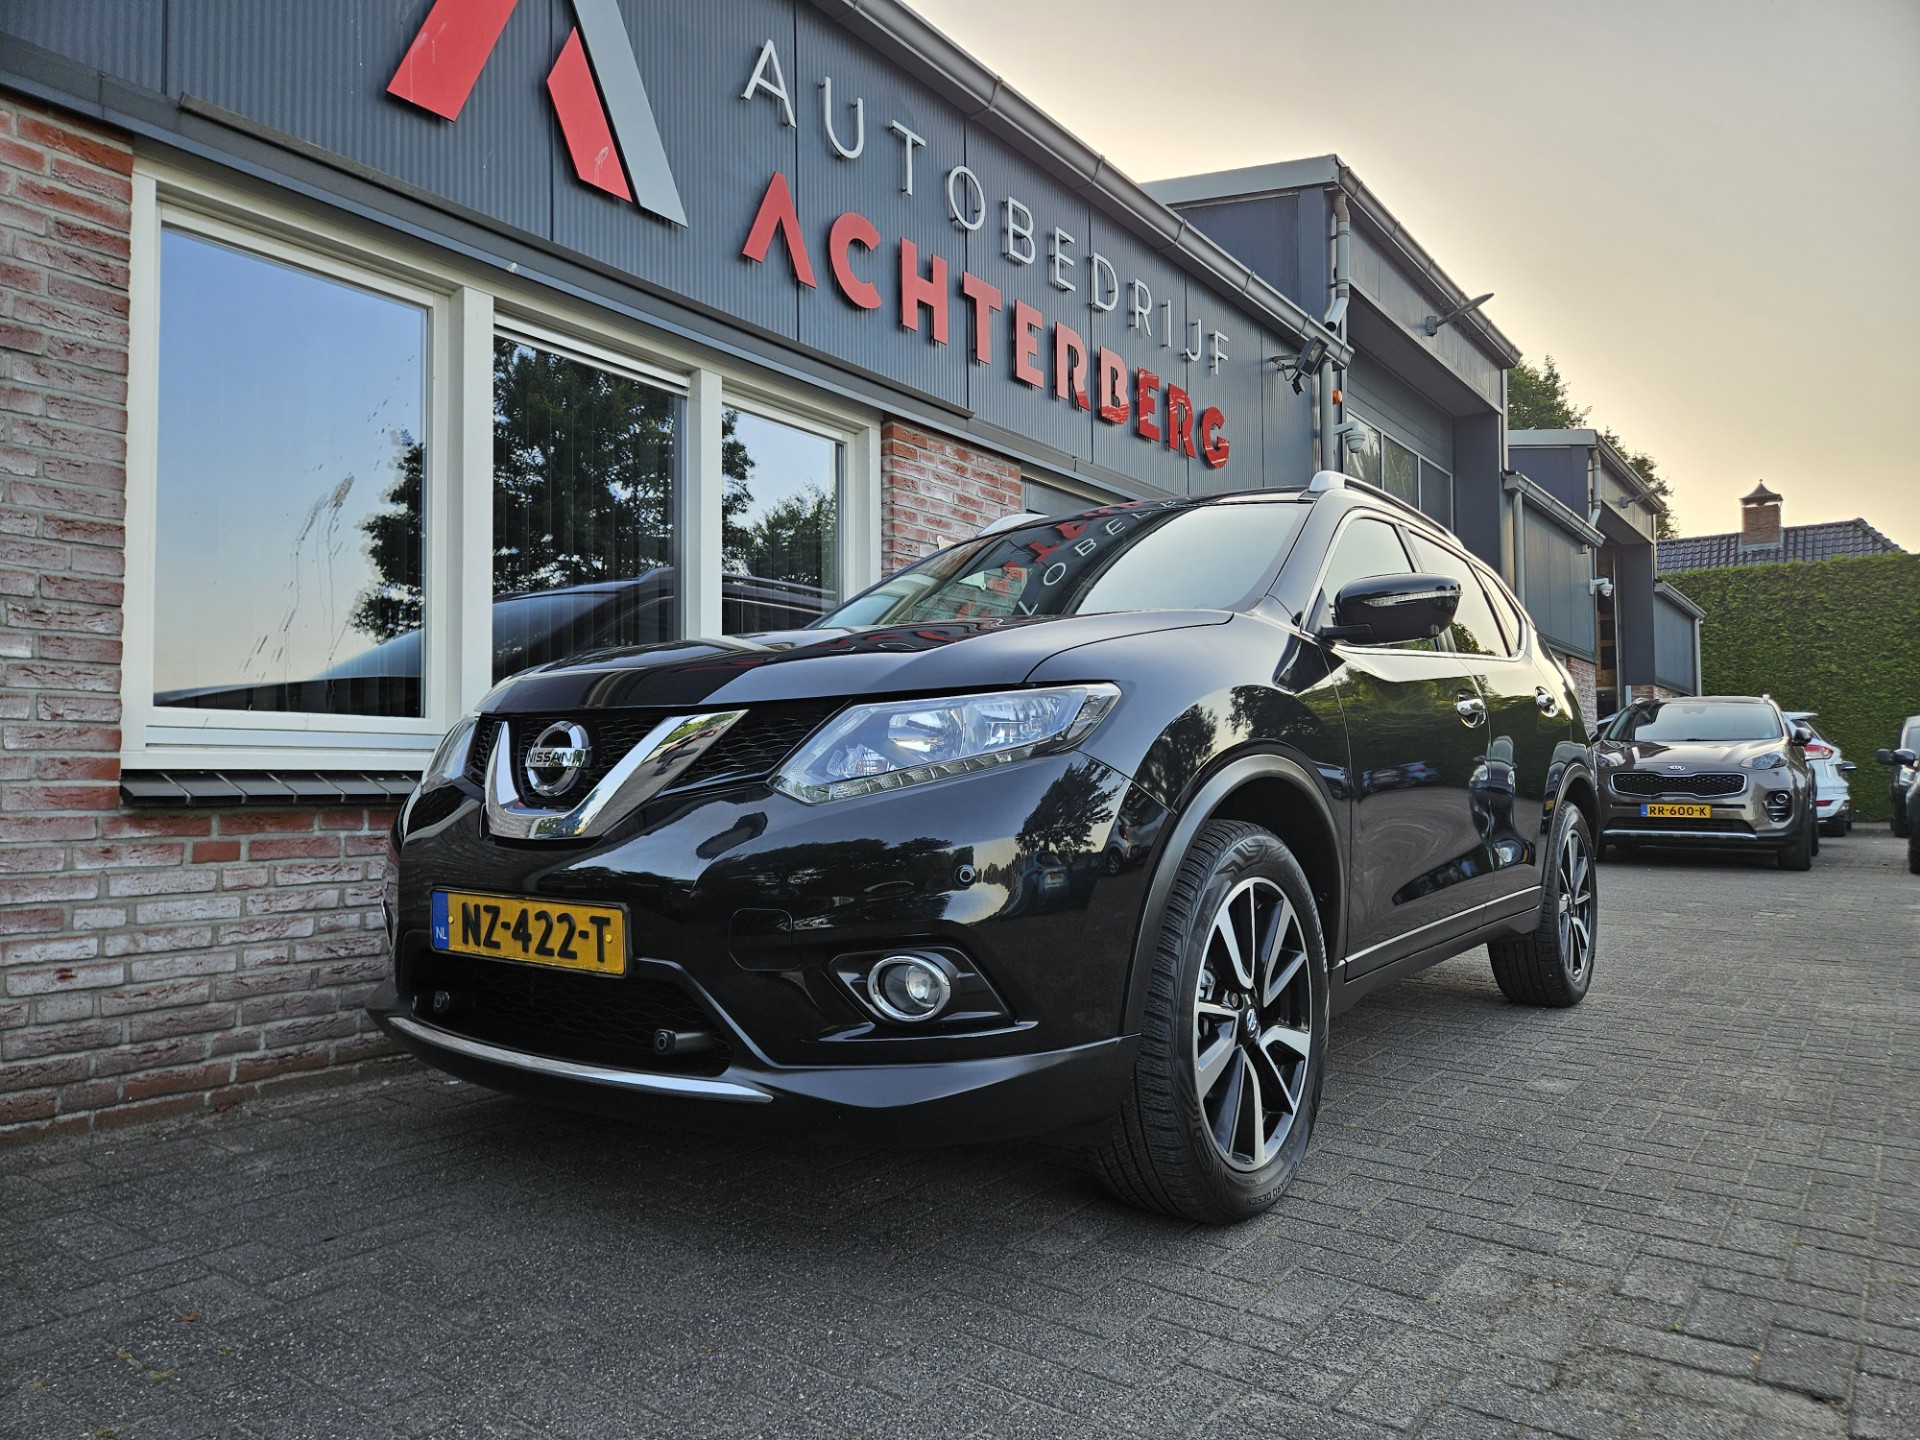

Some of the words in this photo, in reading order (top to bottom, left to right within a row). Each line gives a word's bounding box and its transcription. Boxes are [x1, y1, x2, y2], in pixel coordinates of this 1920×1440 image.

[741, 39, 1230, 376] AUTOBEDRIJF
[742, 170, 1231, 470] ACHTERBERG
[527, 751, 573, 763] NISSAN
[1649, 806, 1707, 817] RR-600-K
[436, 926, 448, 940] NL
[461, 902, 611, 963] NZ-422-T
